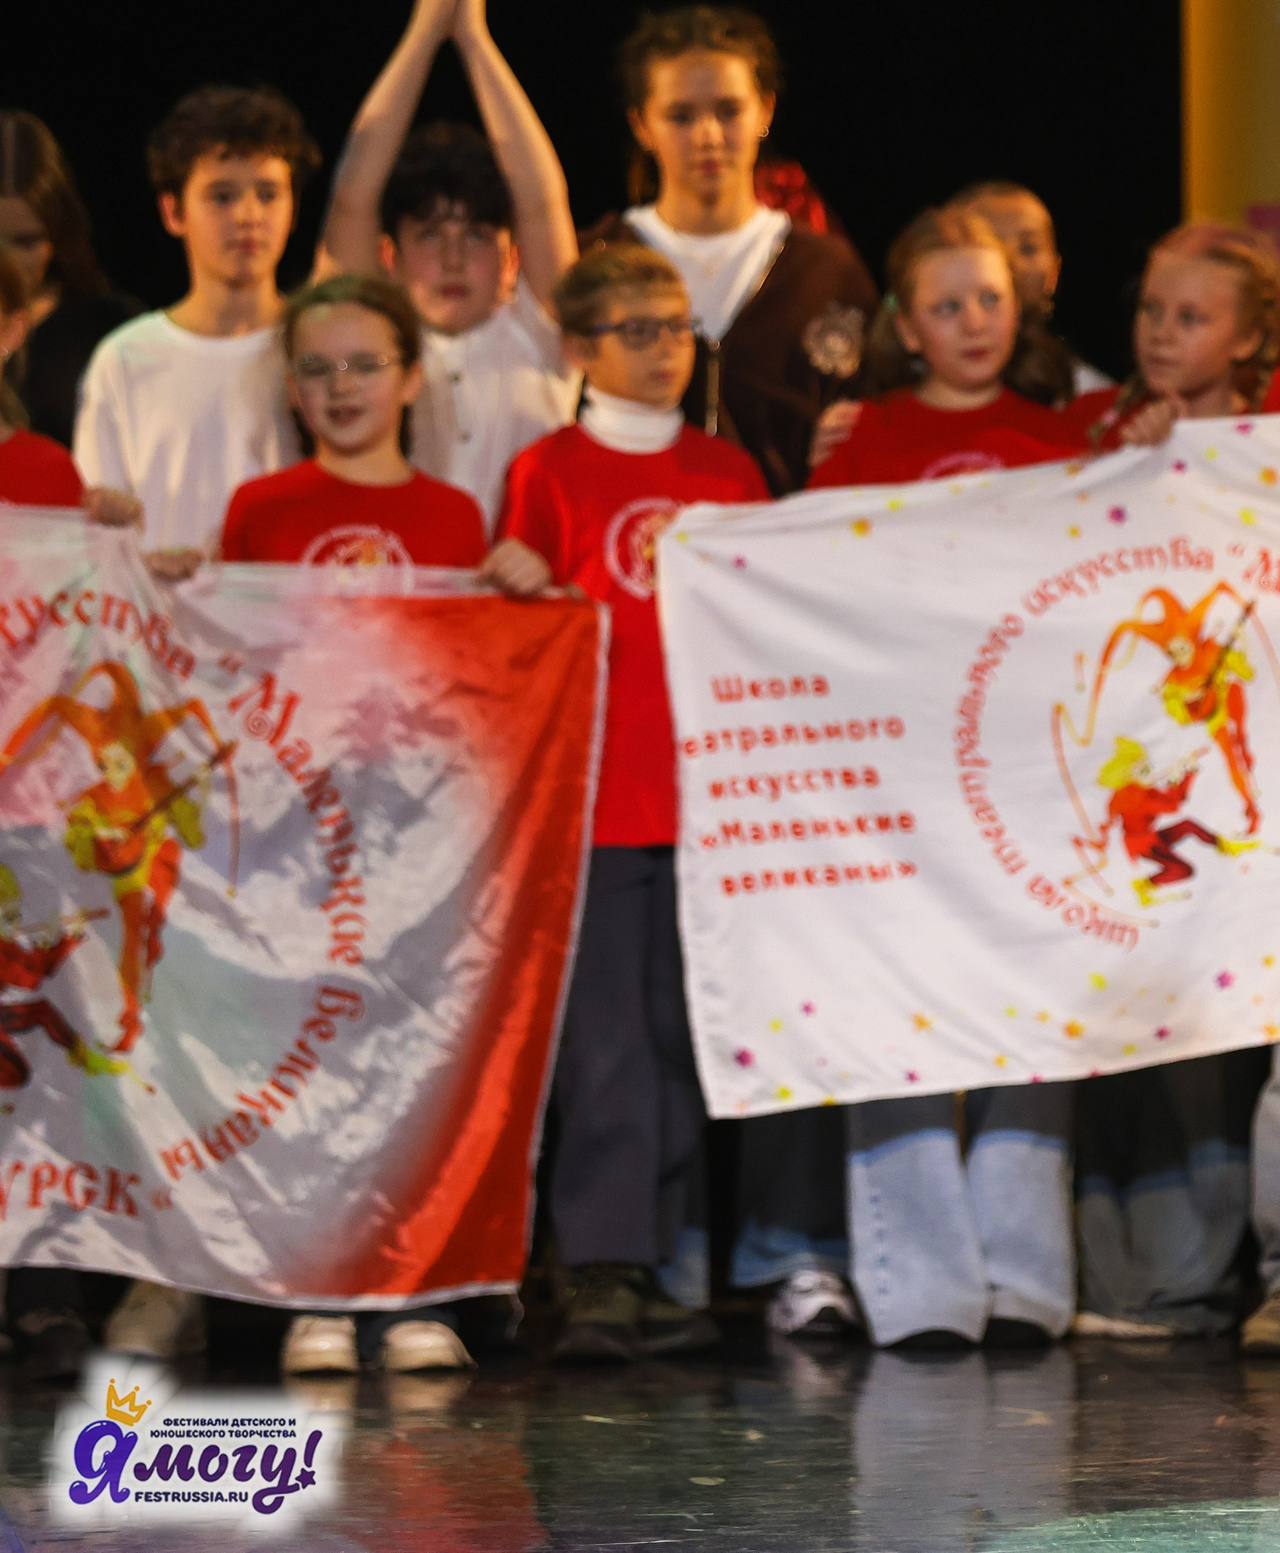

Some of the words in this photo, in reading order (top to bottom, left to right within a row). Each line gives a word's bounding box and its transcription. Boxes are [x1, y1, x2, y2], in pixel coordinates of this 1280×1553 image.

[710, 675, 831, 702] Школа
[681, 714, 906, 757] еатрального
[708, 764, 881, 802] искусства
[701, 810, 916, 848] «Маленькие
[720, 859, 917, 897] великаны»
